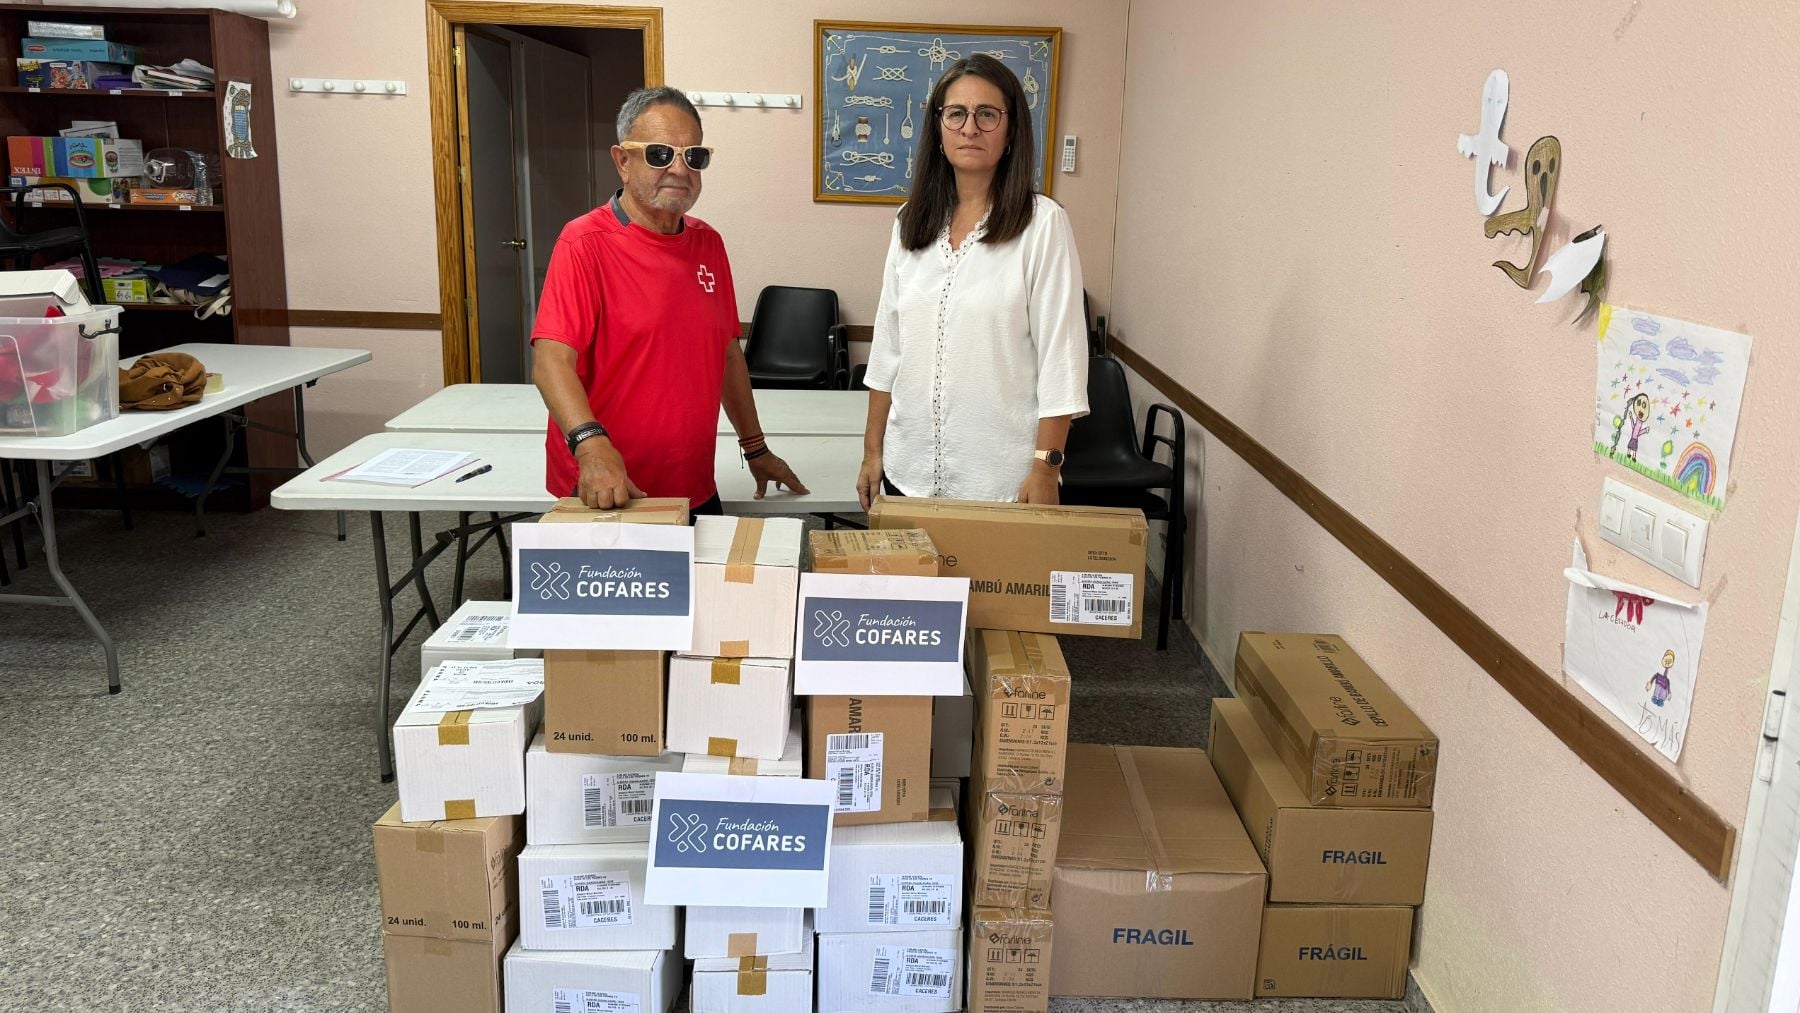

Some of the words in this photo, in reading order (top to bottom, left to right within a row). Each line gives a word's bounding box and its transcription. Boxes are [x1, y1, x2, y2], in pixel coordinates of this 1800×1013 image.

[578, 565, 642, 579] Fundación
[576, 581, 670, 598] COFARES
[968, 579, 1002, 594] AMBÚ
[1005, 582, 1050, 597] AMARIL
[858, 613, 917, 627] Fundación
[855, 629, 942, 646] COFARES
[848, 697, 863, 734] AMAR
[553, 732, 566, 741] 24
[568, 732, 594, 742] unid.
[620, 733, 639, 743] 100
[641, 734, 657, 743] ml.
[716, 817, 779, 832] Fundación
[713, 833, 806, 852] COFARES
[1322, 850, 1387, 865] FRAGIL
[388, 916, 400, 925] 24
[402, 918, 427, 927] unid.
[452, 920, 469, 929] 100
[472, 921, 487, 930] ml.
[999, 933, 1032, 945] farline
[1113, 927, 1194, 946] FRAGIL
[1299, 944, 1368, 961] FRÁGIL
